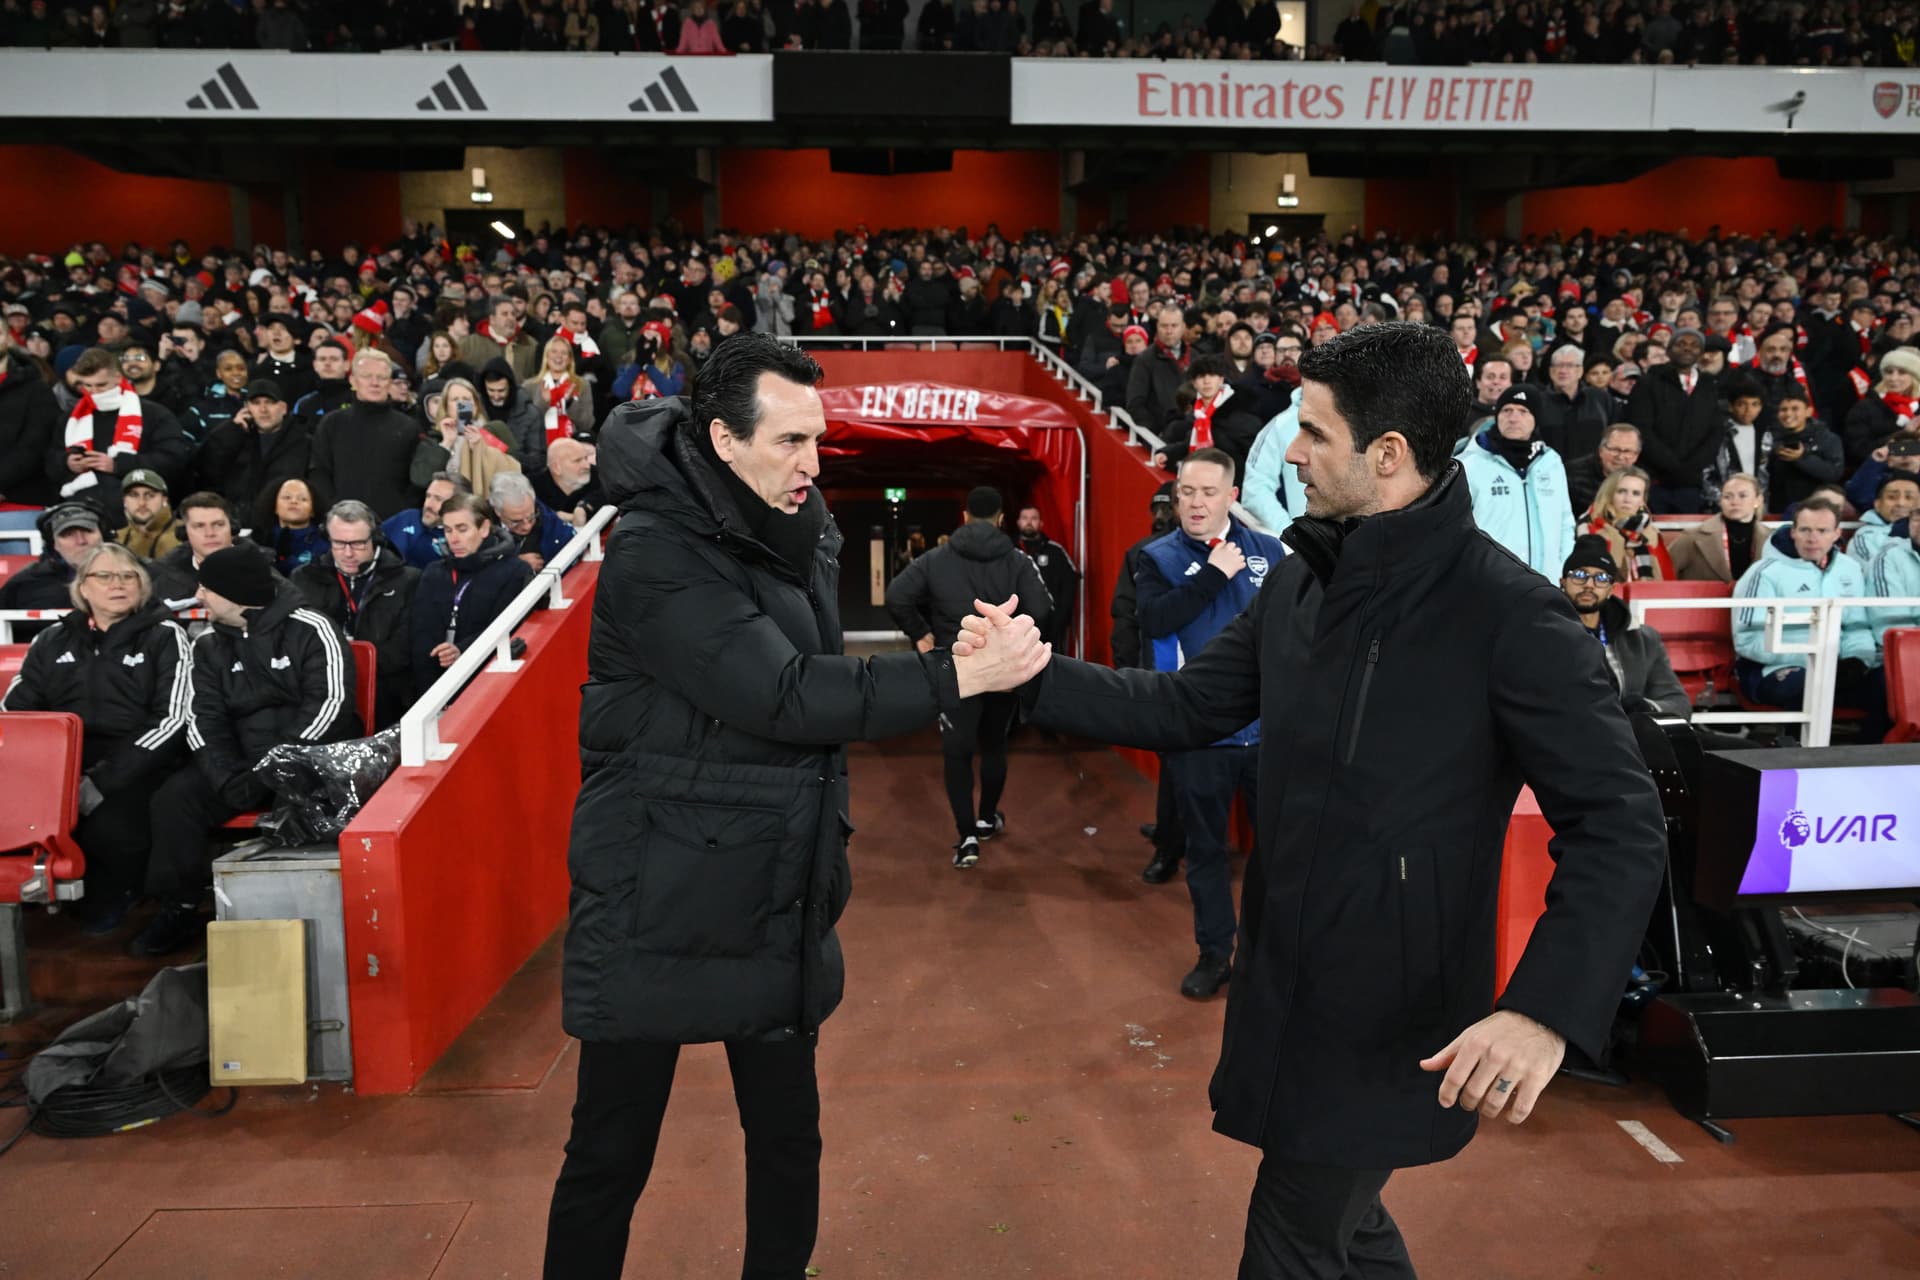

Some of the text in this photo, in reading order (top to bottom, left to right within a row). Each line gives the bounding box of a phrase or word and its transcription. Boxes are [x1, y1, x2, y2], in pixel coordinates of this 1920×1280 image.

[1137, 72, 1533, 121] Emirates FLY BETTER
[861, 385, 980, 421] FLY BETTER
[1815, 813, 1897, 844] VAR
